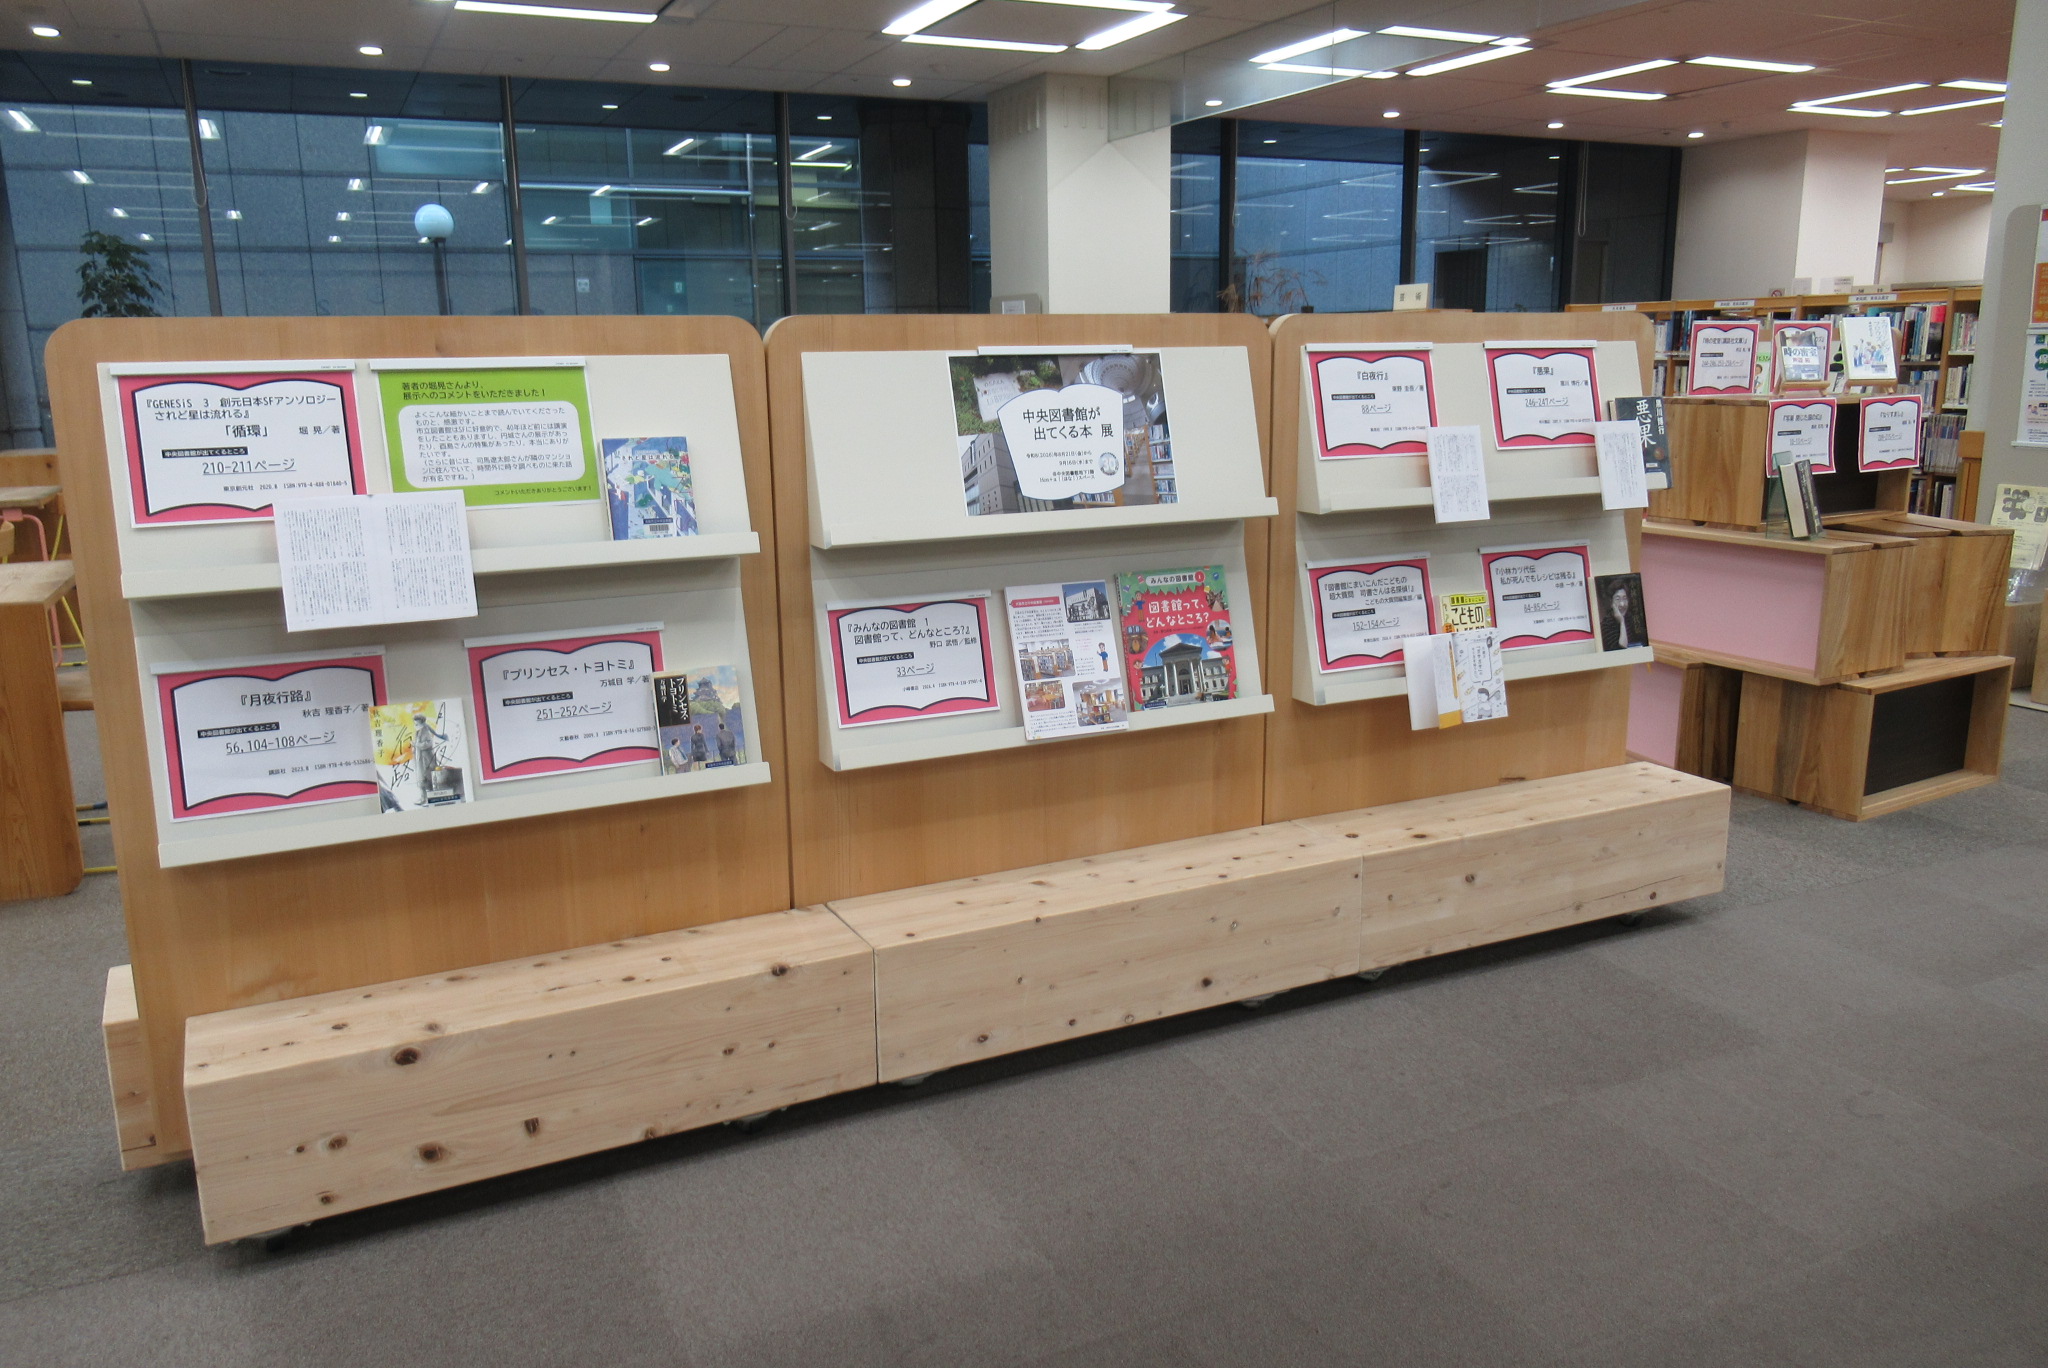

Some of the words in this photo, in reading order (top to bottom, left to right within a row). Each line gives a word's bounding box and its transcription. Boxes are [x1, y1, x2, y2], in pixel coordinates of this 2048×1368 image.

[1356, 370, 1389, 381] 『白夜行』
[203, 398, 210, 408] 3
[219, 396, 337, 408] 創元日本SFアンソロジー
[1361, 403, 1392, 415] 88ページ
[154, 409, 250, 422] されど星は流れる』
[1022, 406, 1101, 423] 中央図書館が
[225, 424, 269, 438] 「循環」
[1635, 398, 1657, 448] 悪果
[1034, 424, 1093, 440] 出てくる本
[1100, 423, 1114, 438] 展
[202, 458, 296, 475] 210-211ページ
[1150, 573, 1194, 585] みんなの図書館
[1451, 605, 1484, 626] こどもの
[847, 618, 917, 633] 『みんなの図書館
[1352, 616, 1400, 632] 152-154ページ
[502, 659, 636, 681] 『プリンセス・トヨトミ』
[895, 662, 935, 678] 33ページ
[600, 677, 623, 688] 万城目
[240, 689, 312, 707] 『月夜行路』
[302, 708, 321, 719] 秋吉
[536, 701, 613, 721] 251-252ページ
